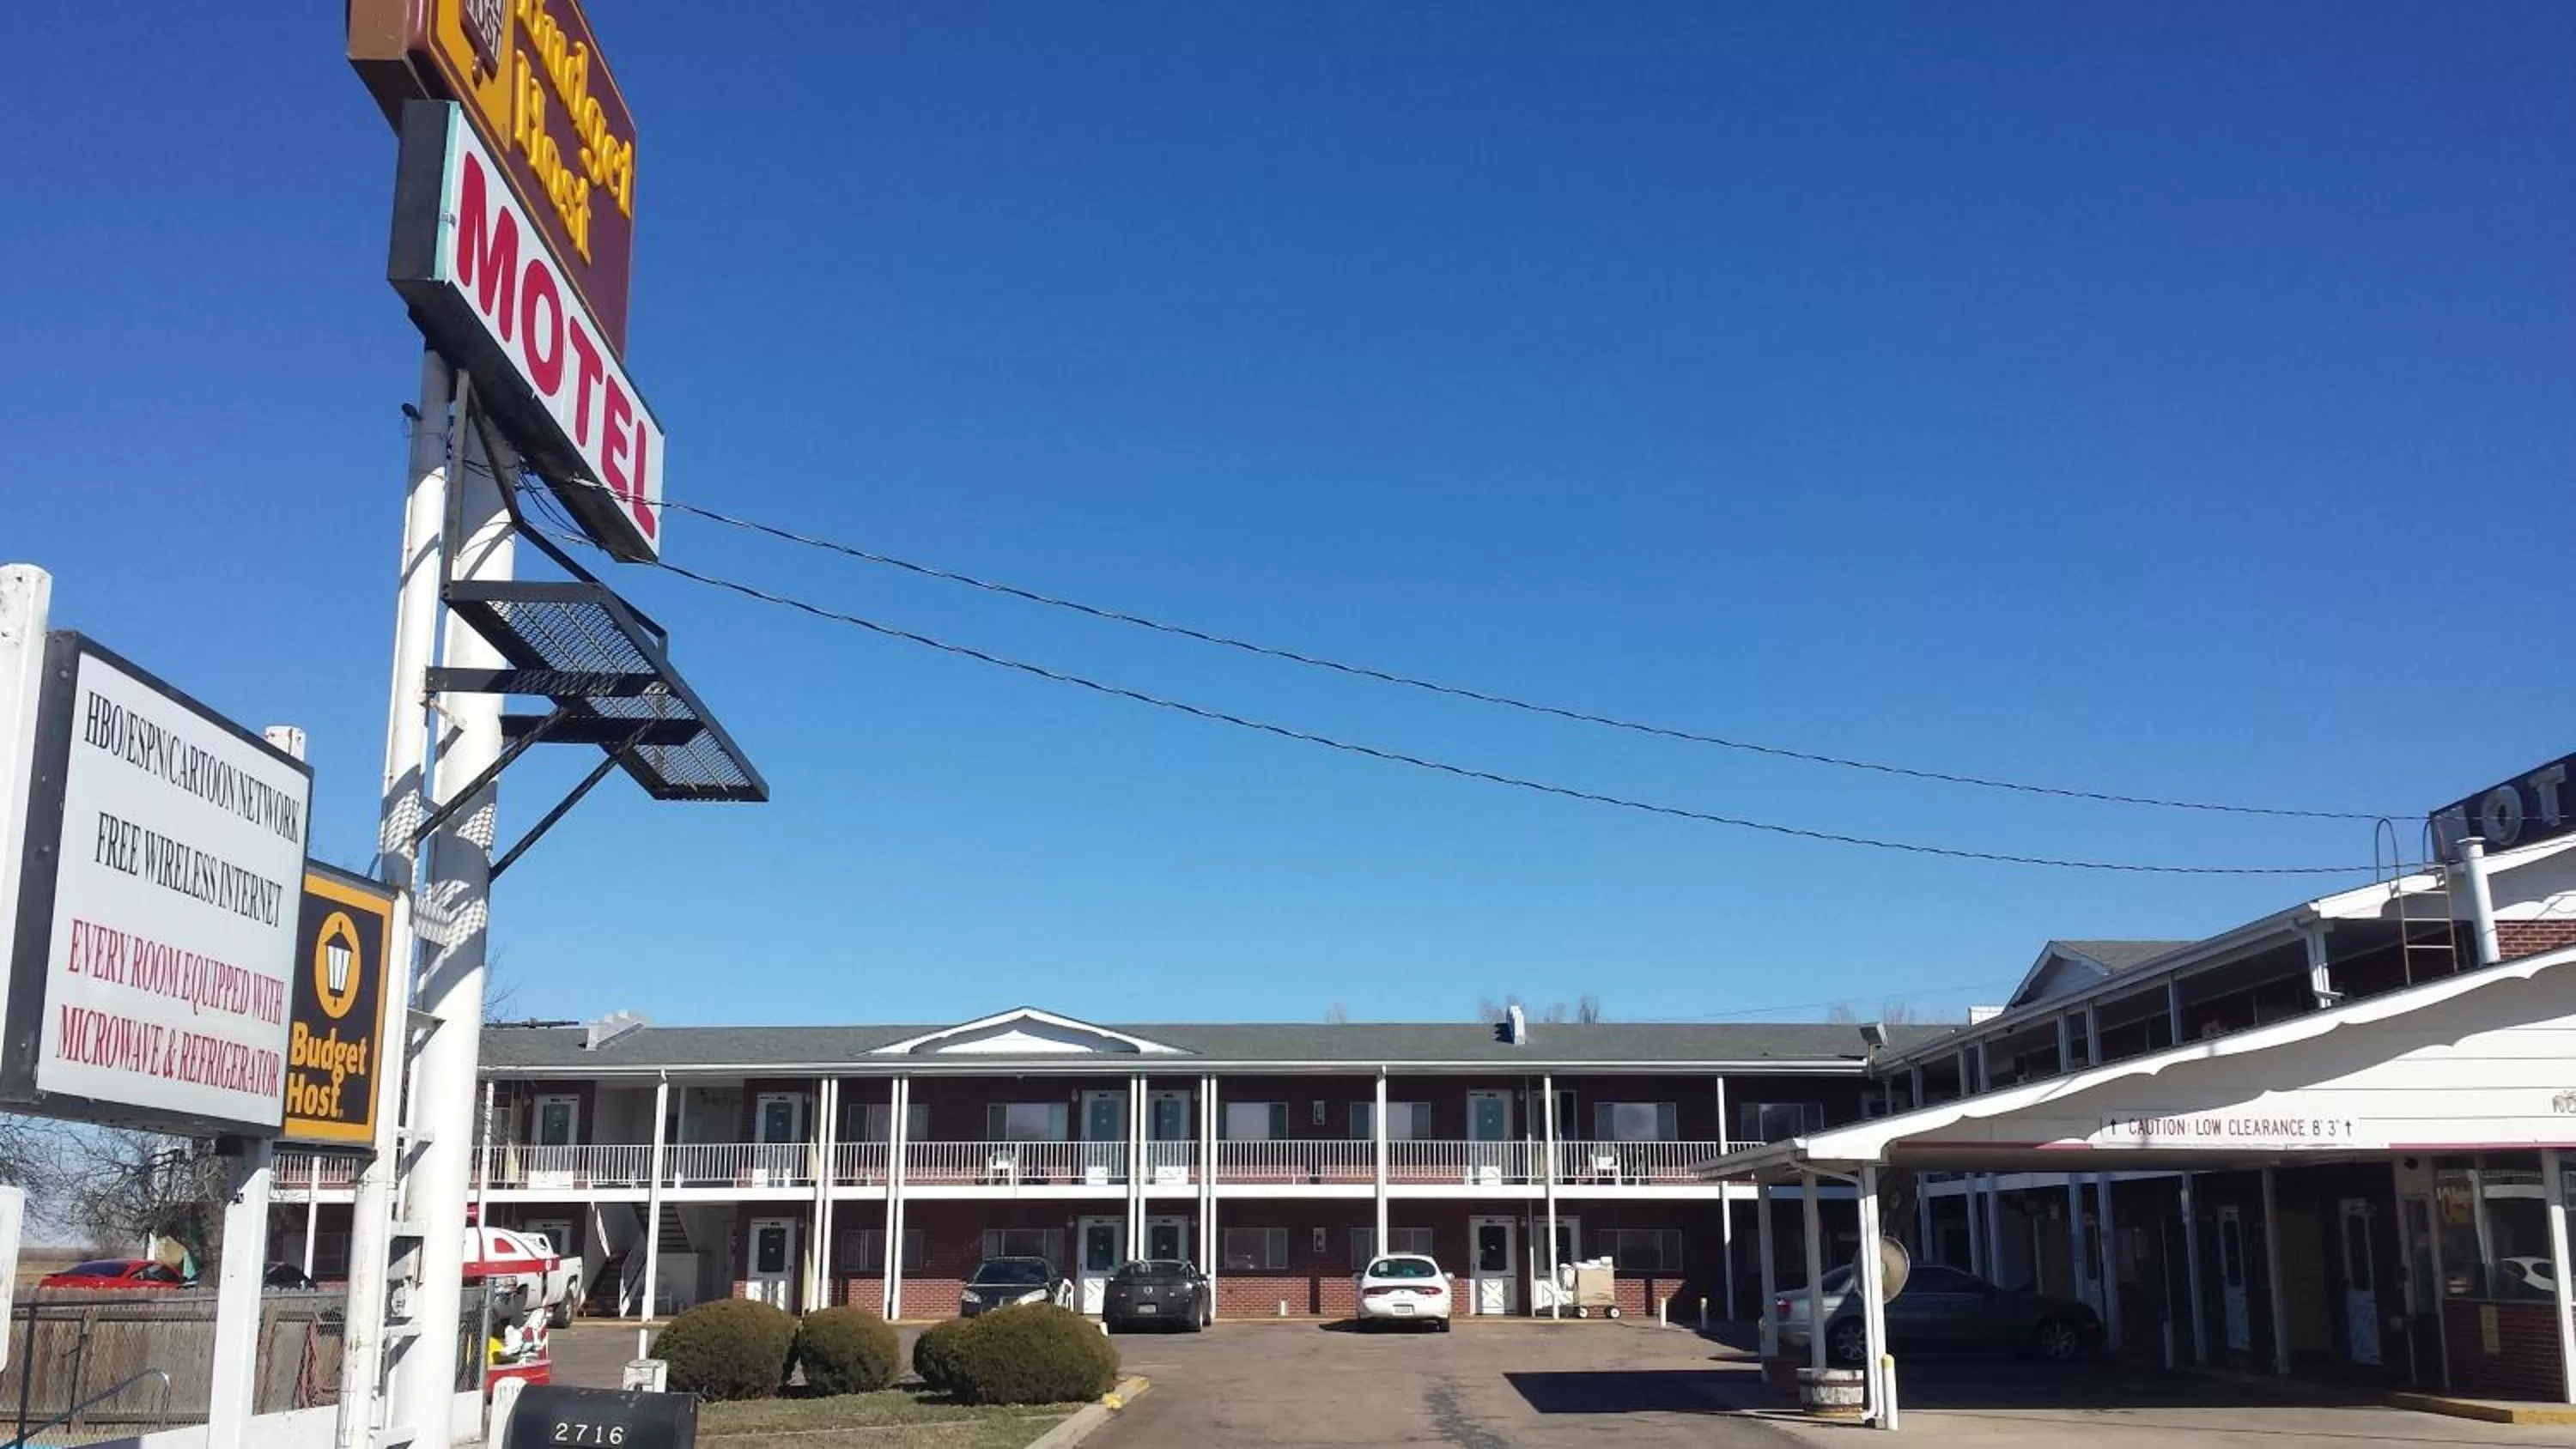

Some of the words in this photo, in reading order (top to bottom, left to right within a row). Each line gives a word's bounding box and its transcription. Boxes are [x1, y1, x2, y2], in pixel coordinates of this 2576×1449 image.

[515, 49, 591, 265] Host
[456, 150, 655, 541] MOTEL
[84, 690, 237, 811] HBO/ESPN/CARTOON
[237, 770, 300, 845] NETWORK
[95, 811, 141, 876] FREE
[144, 829, 217, 905] WIRELESS
[217, 860, 283, 928] INTERNET
[69, 919, 131, 985] EVERY
[131, 937, 180, 998] ROOM
[181, 952, 251, 1016] EQUIPPED
[252, 973, 284, 1026] WITH
[56, 1003, 164, 1076] MICROWAVE
[163, 1028, 177, 1079] &
[177, 1031, 280, 1098] REFRIGERATOR
[290, 1021, 368, 1083] Budget
[2196, 1119, 2222, 1136] LOW
[2228, 1119, 2306, 1137] CLEARANCE
[555, 1422, 624, 1445] 2716
